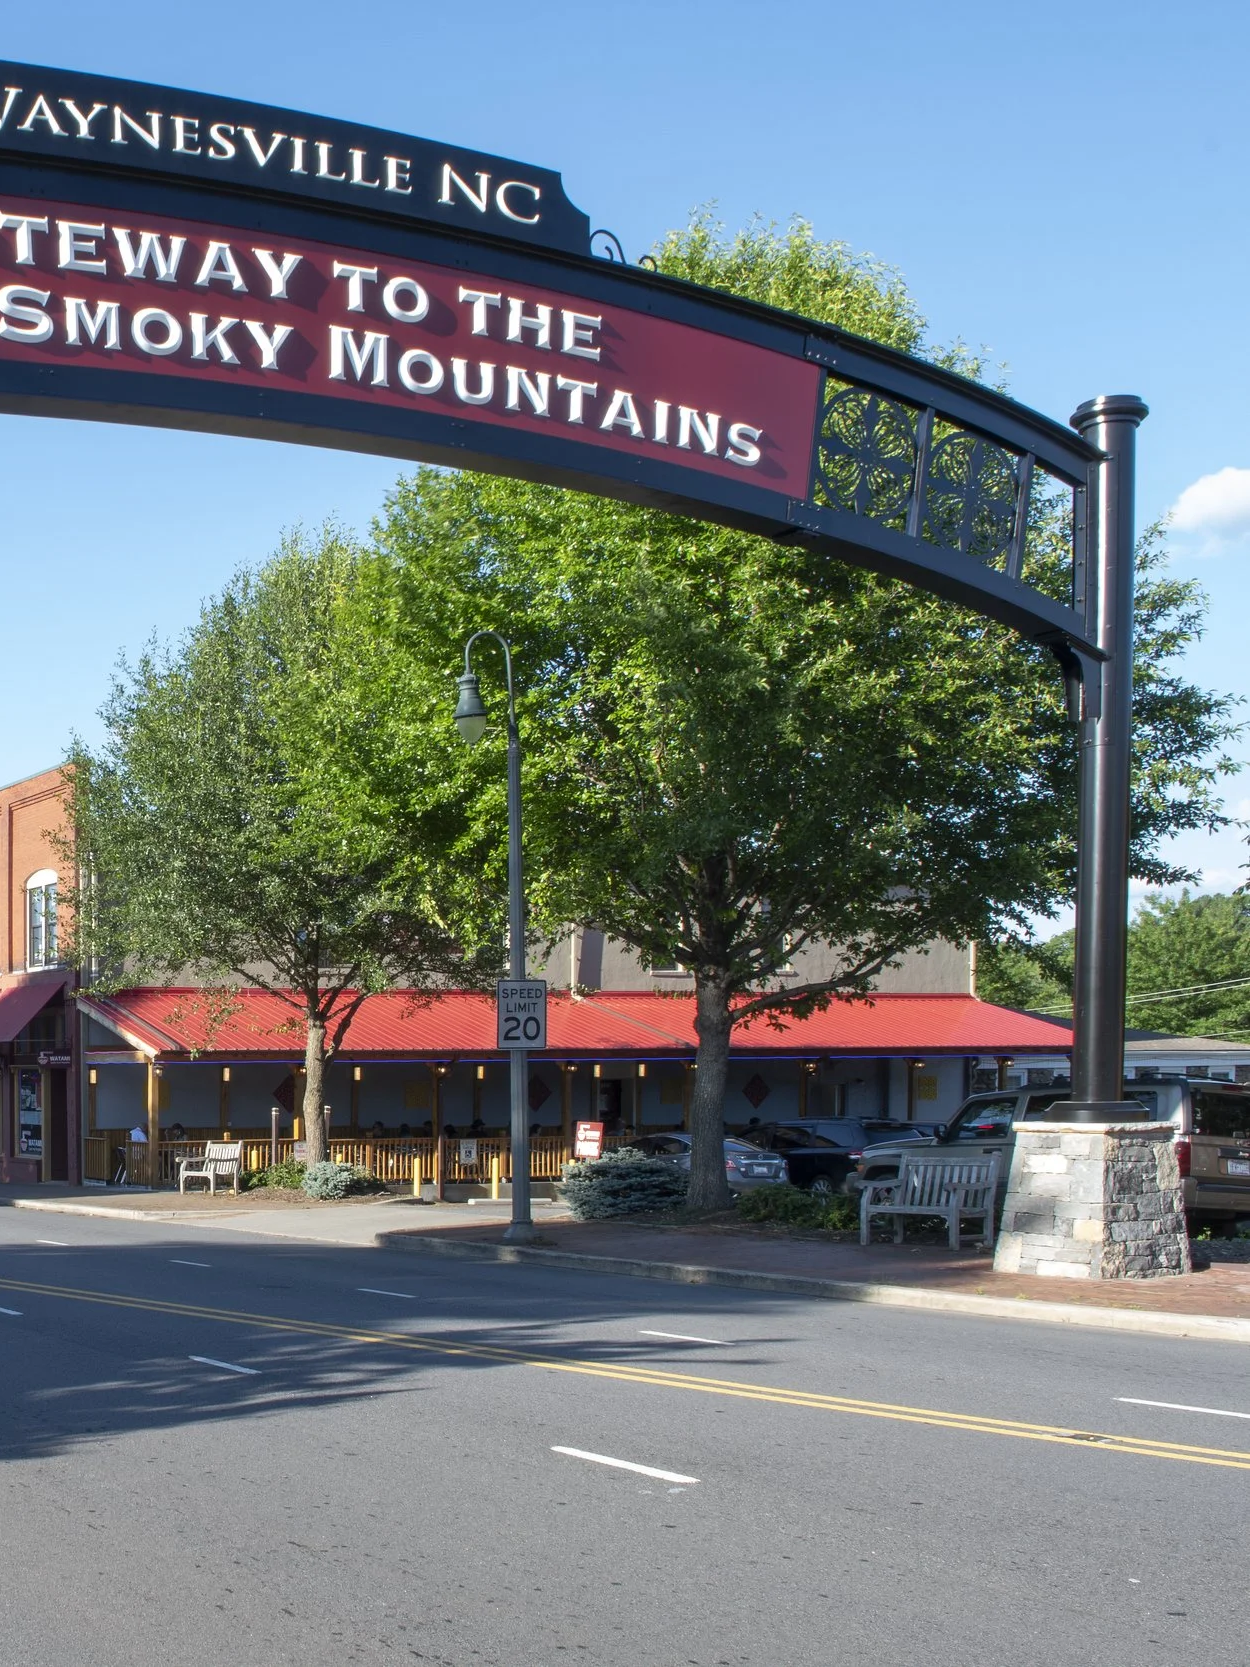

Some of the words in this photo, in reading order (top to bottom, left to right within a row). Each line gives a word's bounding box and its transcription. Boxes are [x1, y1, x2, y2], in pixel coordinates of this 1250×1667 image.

[437, 163, 542, 225] NC
[332, 259, 431, 324] TO
[458, 285, 604, 363] THE
[328, 324, 764, 467] MOUNTAINS
[501, 988, 543, 999] SPEED
[506, 1002, 538, 1013] LIMIT
[503, 1016, 541, 1041] 20
